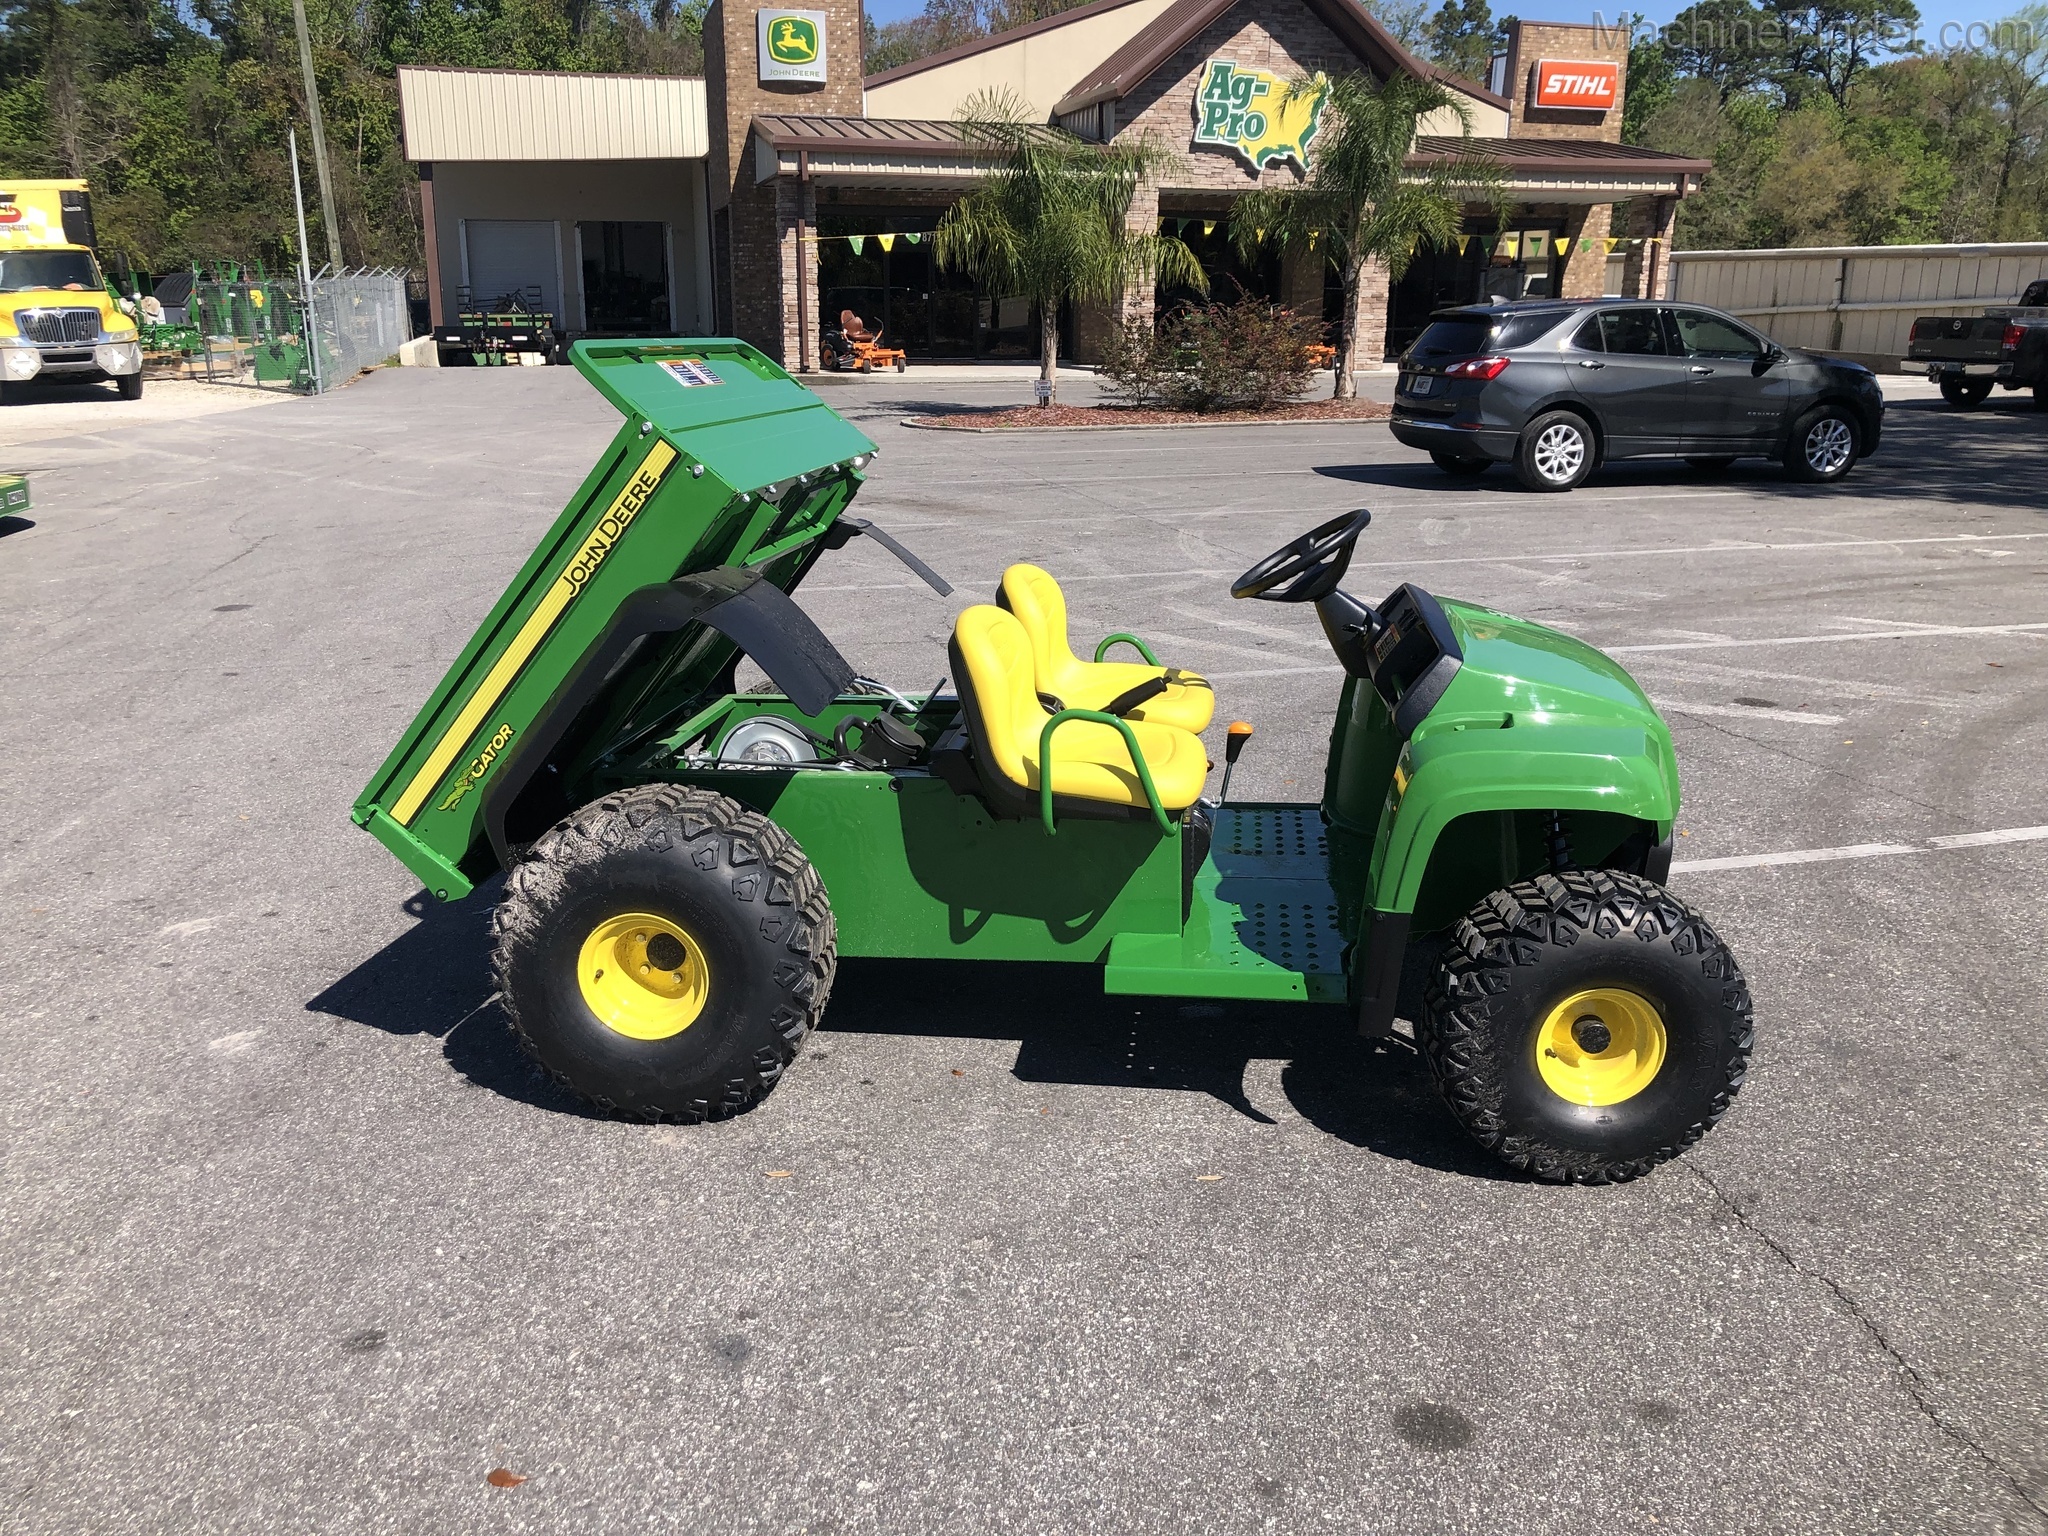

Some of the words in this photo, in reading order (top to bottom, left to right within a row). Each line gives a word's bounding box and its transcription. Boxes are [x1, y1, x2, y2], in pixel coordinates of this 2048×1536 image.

[768, 68, 791, 77] JOHN
[792, 68, 820, 78] DEERE
[1203, 62, 1269, 111] Ag-
[1544, 73, 1612, 96] STIHL
[1200, 101, 1266, 139] Pro
[562, 537, 609, 596] JOHN
[598, 469, 658, 541] DEERE
[471, 723, 515, 778] GATOR
